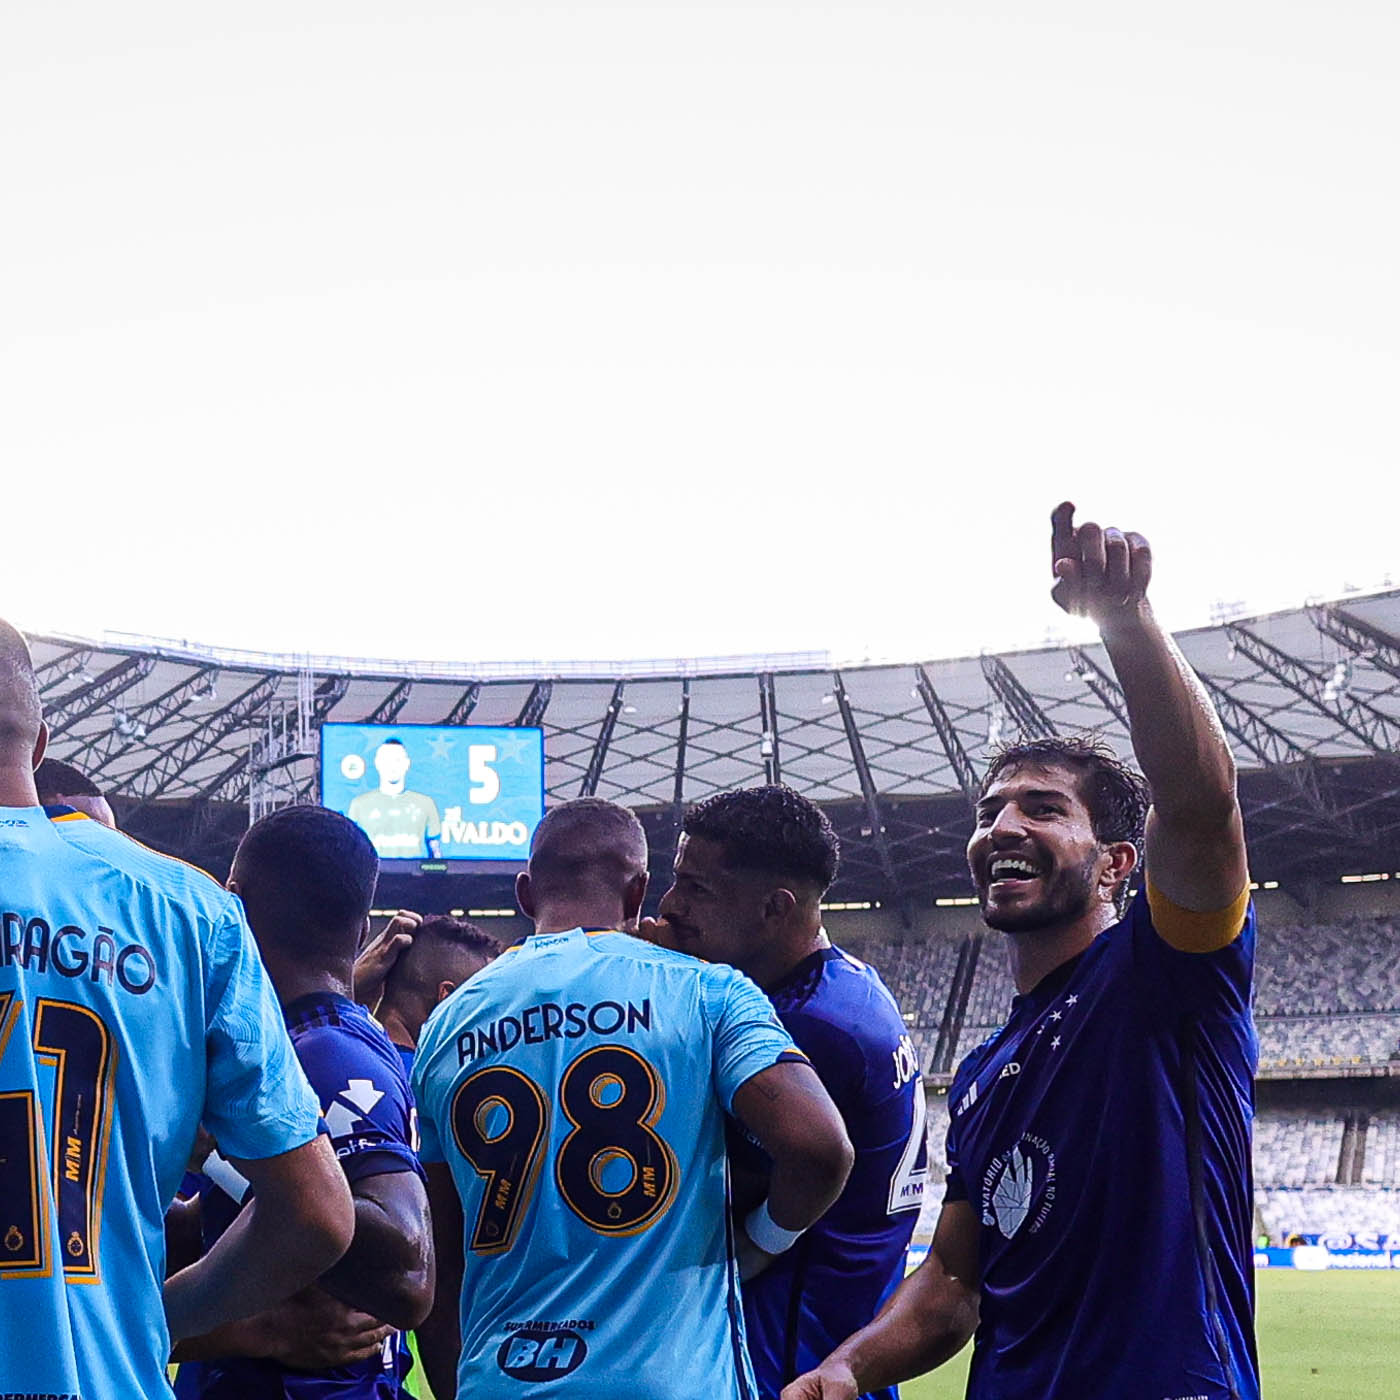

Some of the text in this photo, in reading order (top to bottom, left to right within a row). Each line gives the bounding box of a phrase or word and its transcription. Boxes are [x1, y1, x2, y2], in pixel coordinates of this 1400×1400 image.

[468, 745, 500, 804] 5
[457, 999, 651, 1068] ANDERSON
[450, 1045, 681, 1256] 98
[504, 1337, 579, 1368] BH
